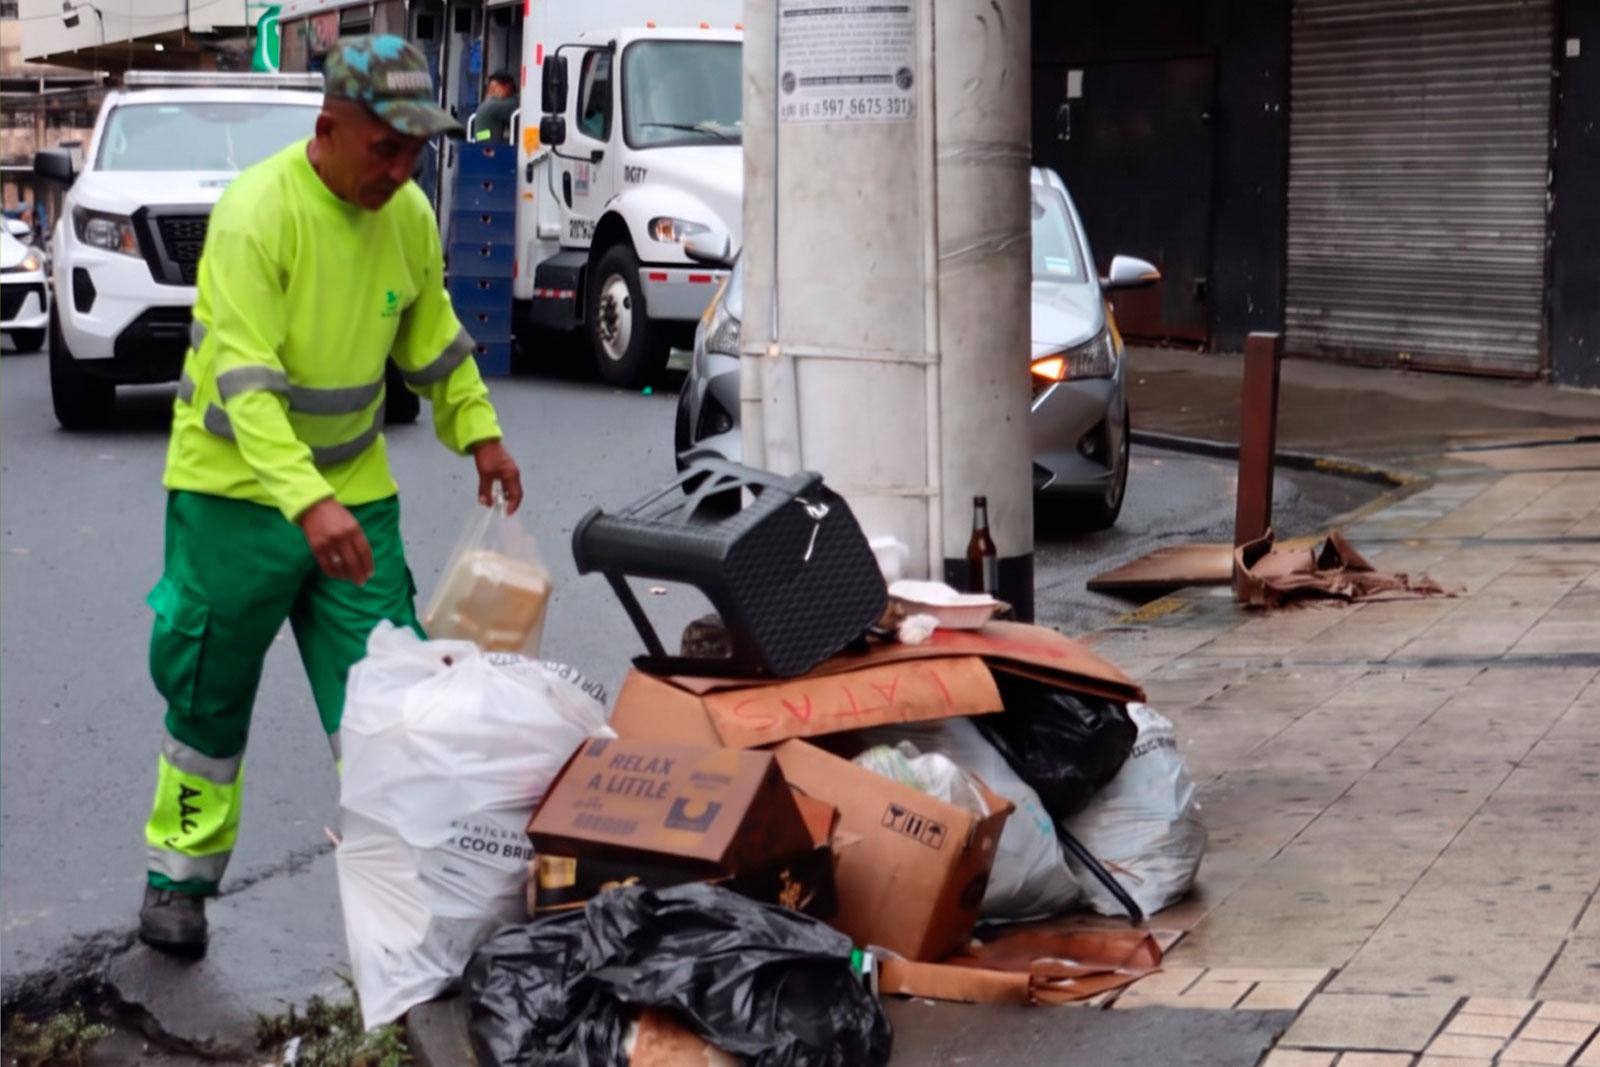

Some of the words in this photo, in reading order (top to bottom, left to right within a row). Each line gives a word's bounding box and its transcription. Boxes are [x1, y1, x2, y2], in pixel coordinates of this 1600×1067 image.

[608, 753, 676, 775] RELAX
[587, 773, 603, 791] A
[606, 775, 672, 800] LITTLE
[459, 836, 499, 855] COO
